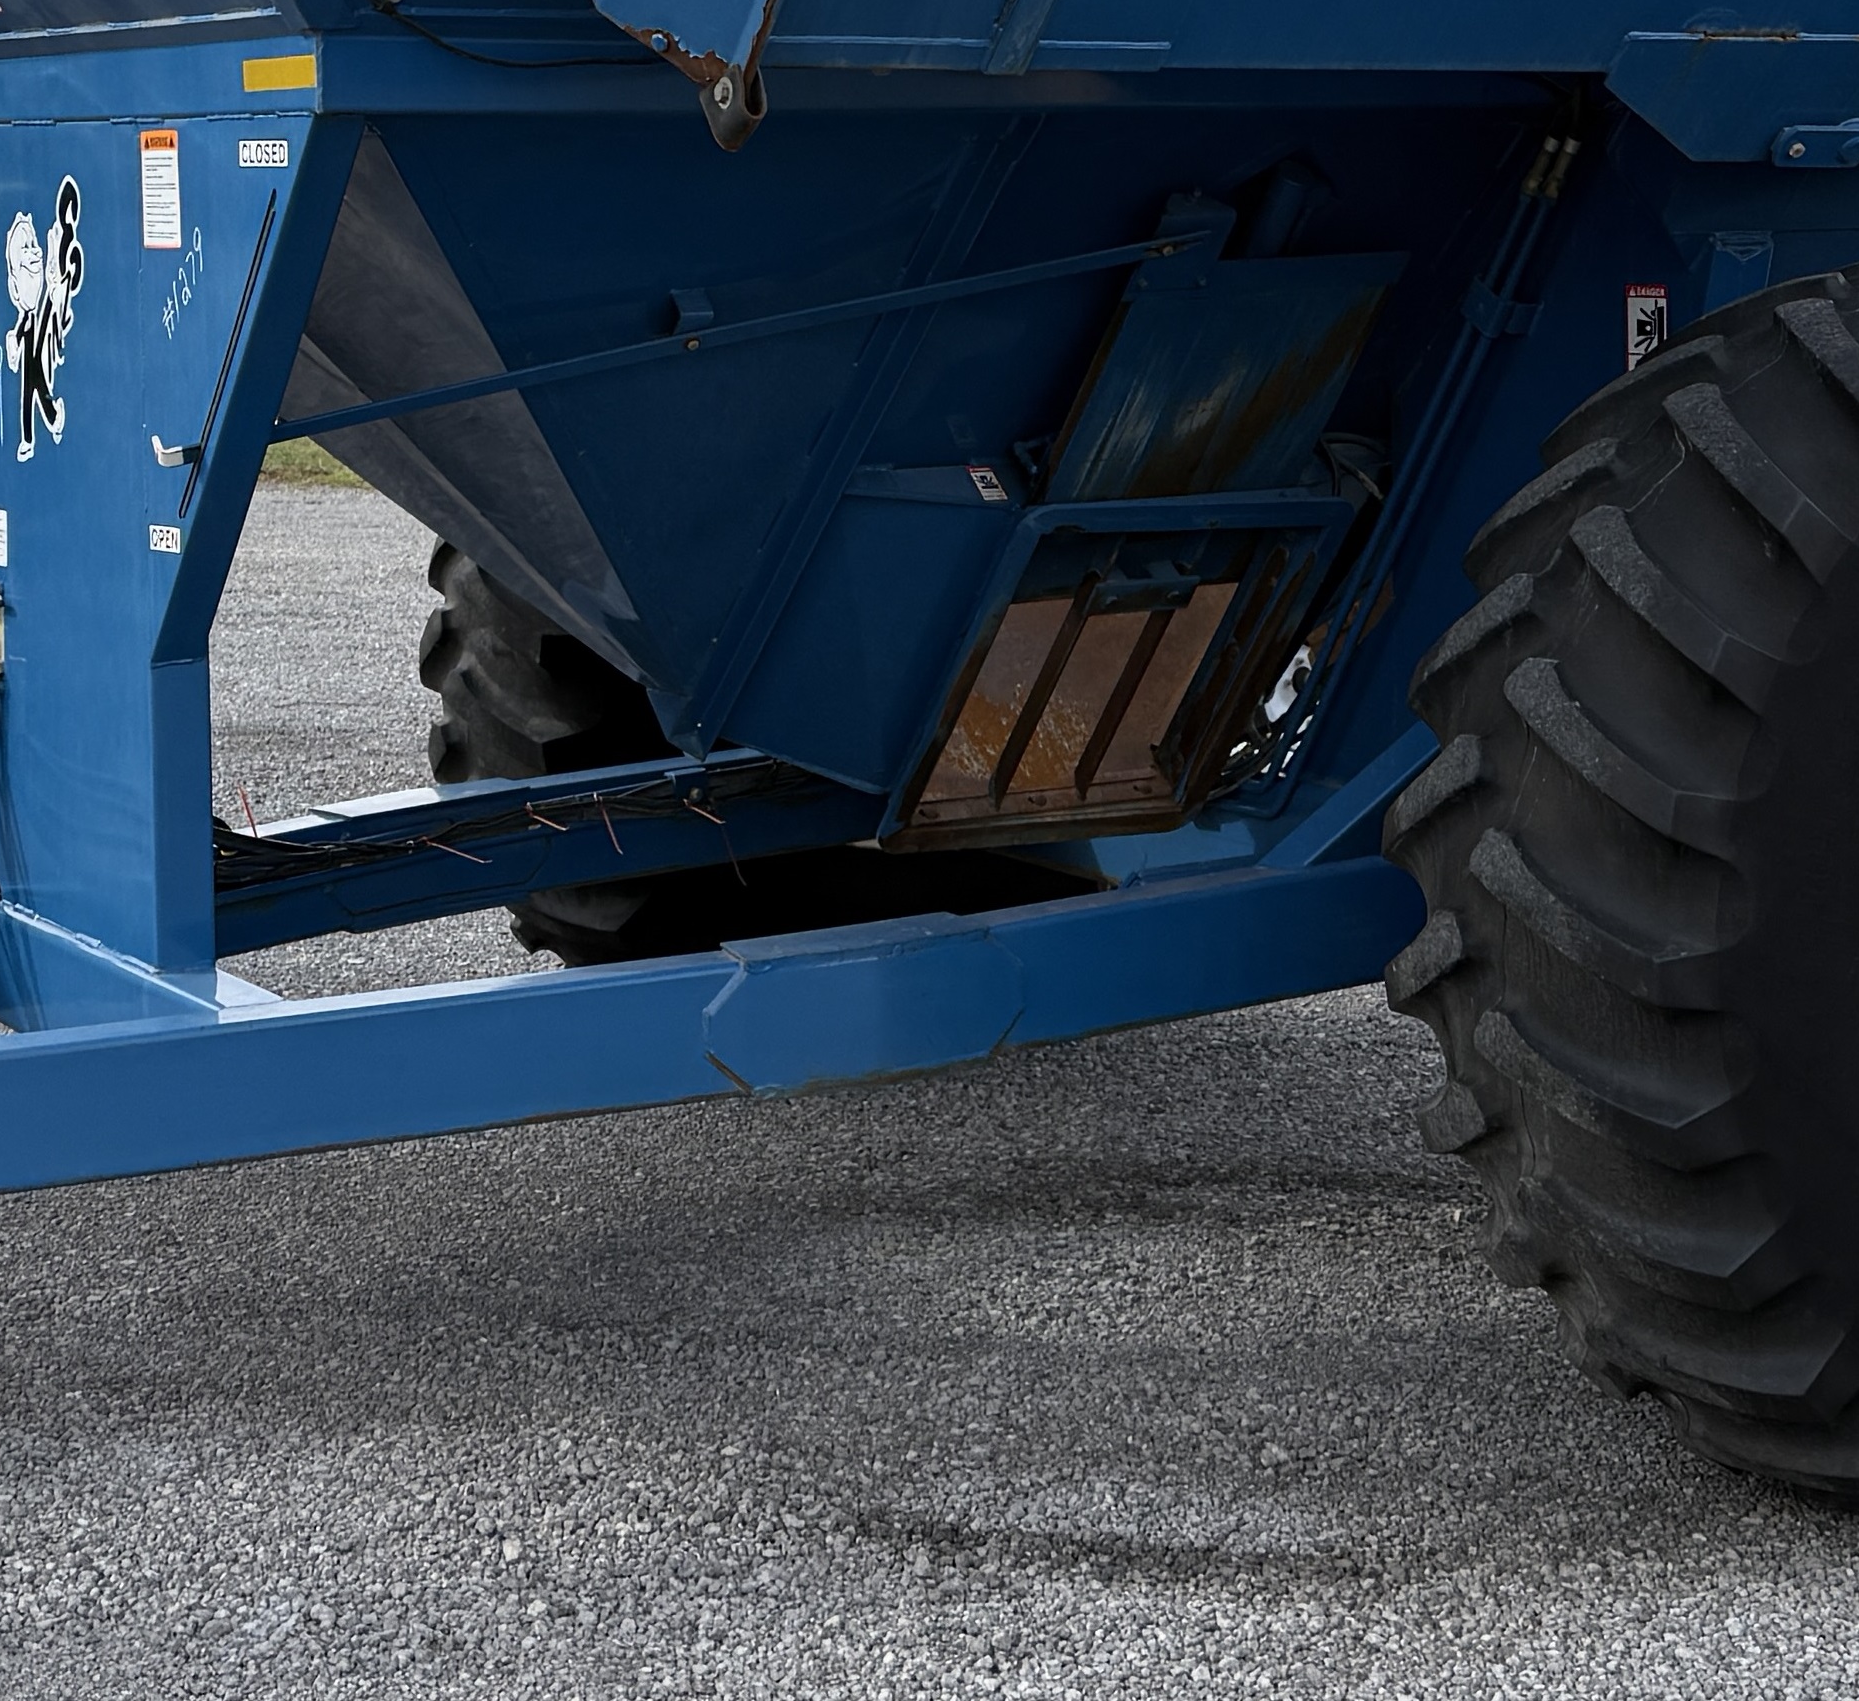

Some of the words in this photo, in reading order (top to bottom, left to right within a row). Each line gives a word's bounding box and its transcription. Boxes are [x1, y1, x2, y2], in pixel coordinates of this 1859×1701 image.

[241, 142, 286, 165] CLOSED
[161, 226, 204, 340] #1279
[150, 527, 180, 551] OPEN
